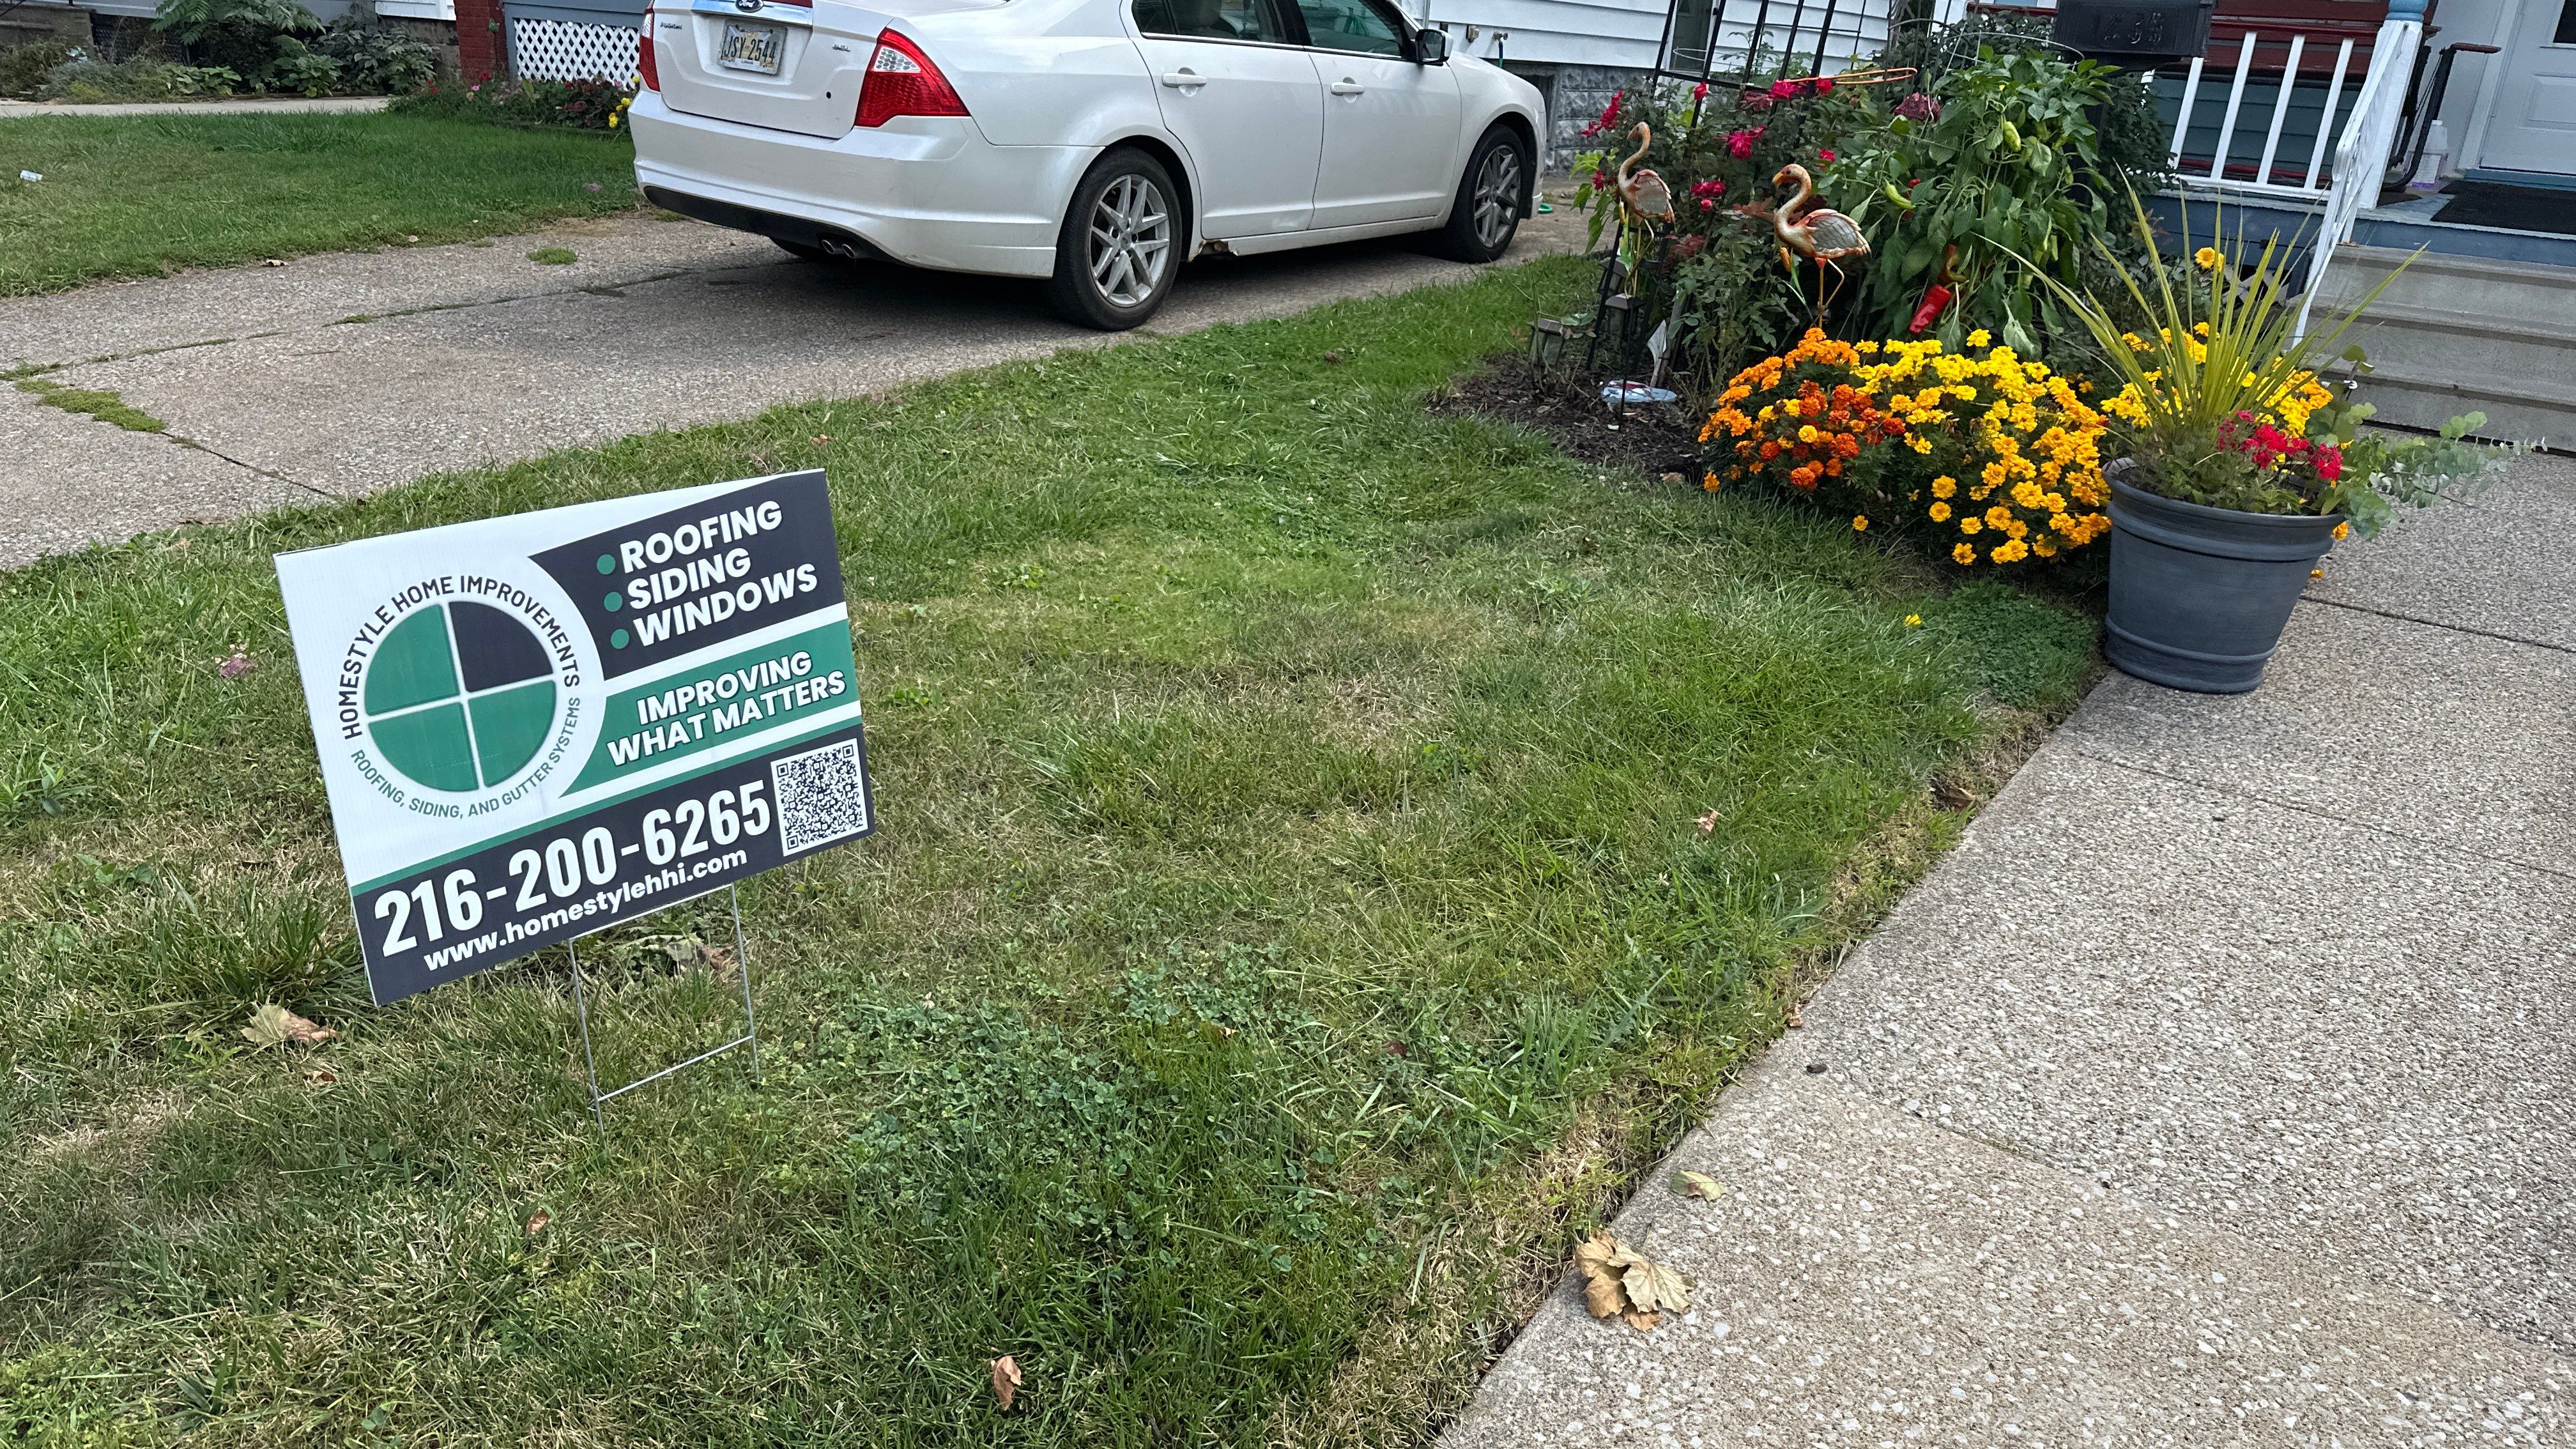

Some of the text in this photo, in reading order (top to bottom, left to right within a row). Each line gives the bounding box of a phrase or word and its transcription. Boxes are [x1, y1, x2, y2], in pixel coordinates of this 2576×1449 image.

[724, 36, 778, 63] JSY 2544
[620, 500, 783, 574] ROOFING
[627, 548, 751, 610] SIDING
[633, 563, 818, 647] WINDOWS
[339, 575, 580, 740] HOMESTYLE HOME IMPROVEMENTS
[637, 651, 813, 725] IMPROVING
[351, 697, 581, 819] ROOFING, SIDING, AND GUTTER SYSTEMS
[606, 670, 846, 767] WHAT MATTERS
[374, 779, 770, 957] 216-200-6265
[424, 847, 747, 972] www.homestylehhi.com
